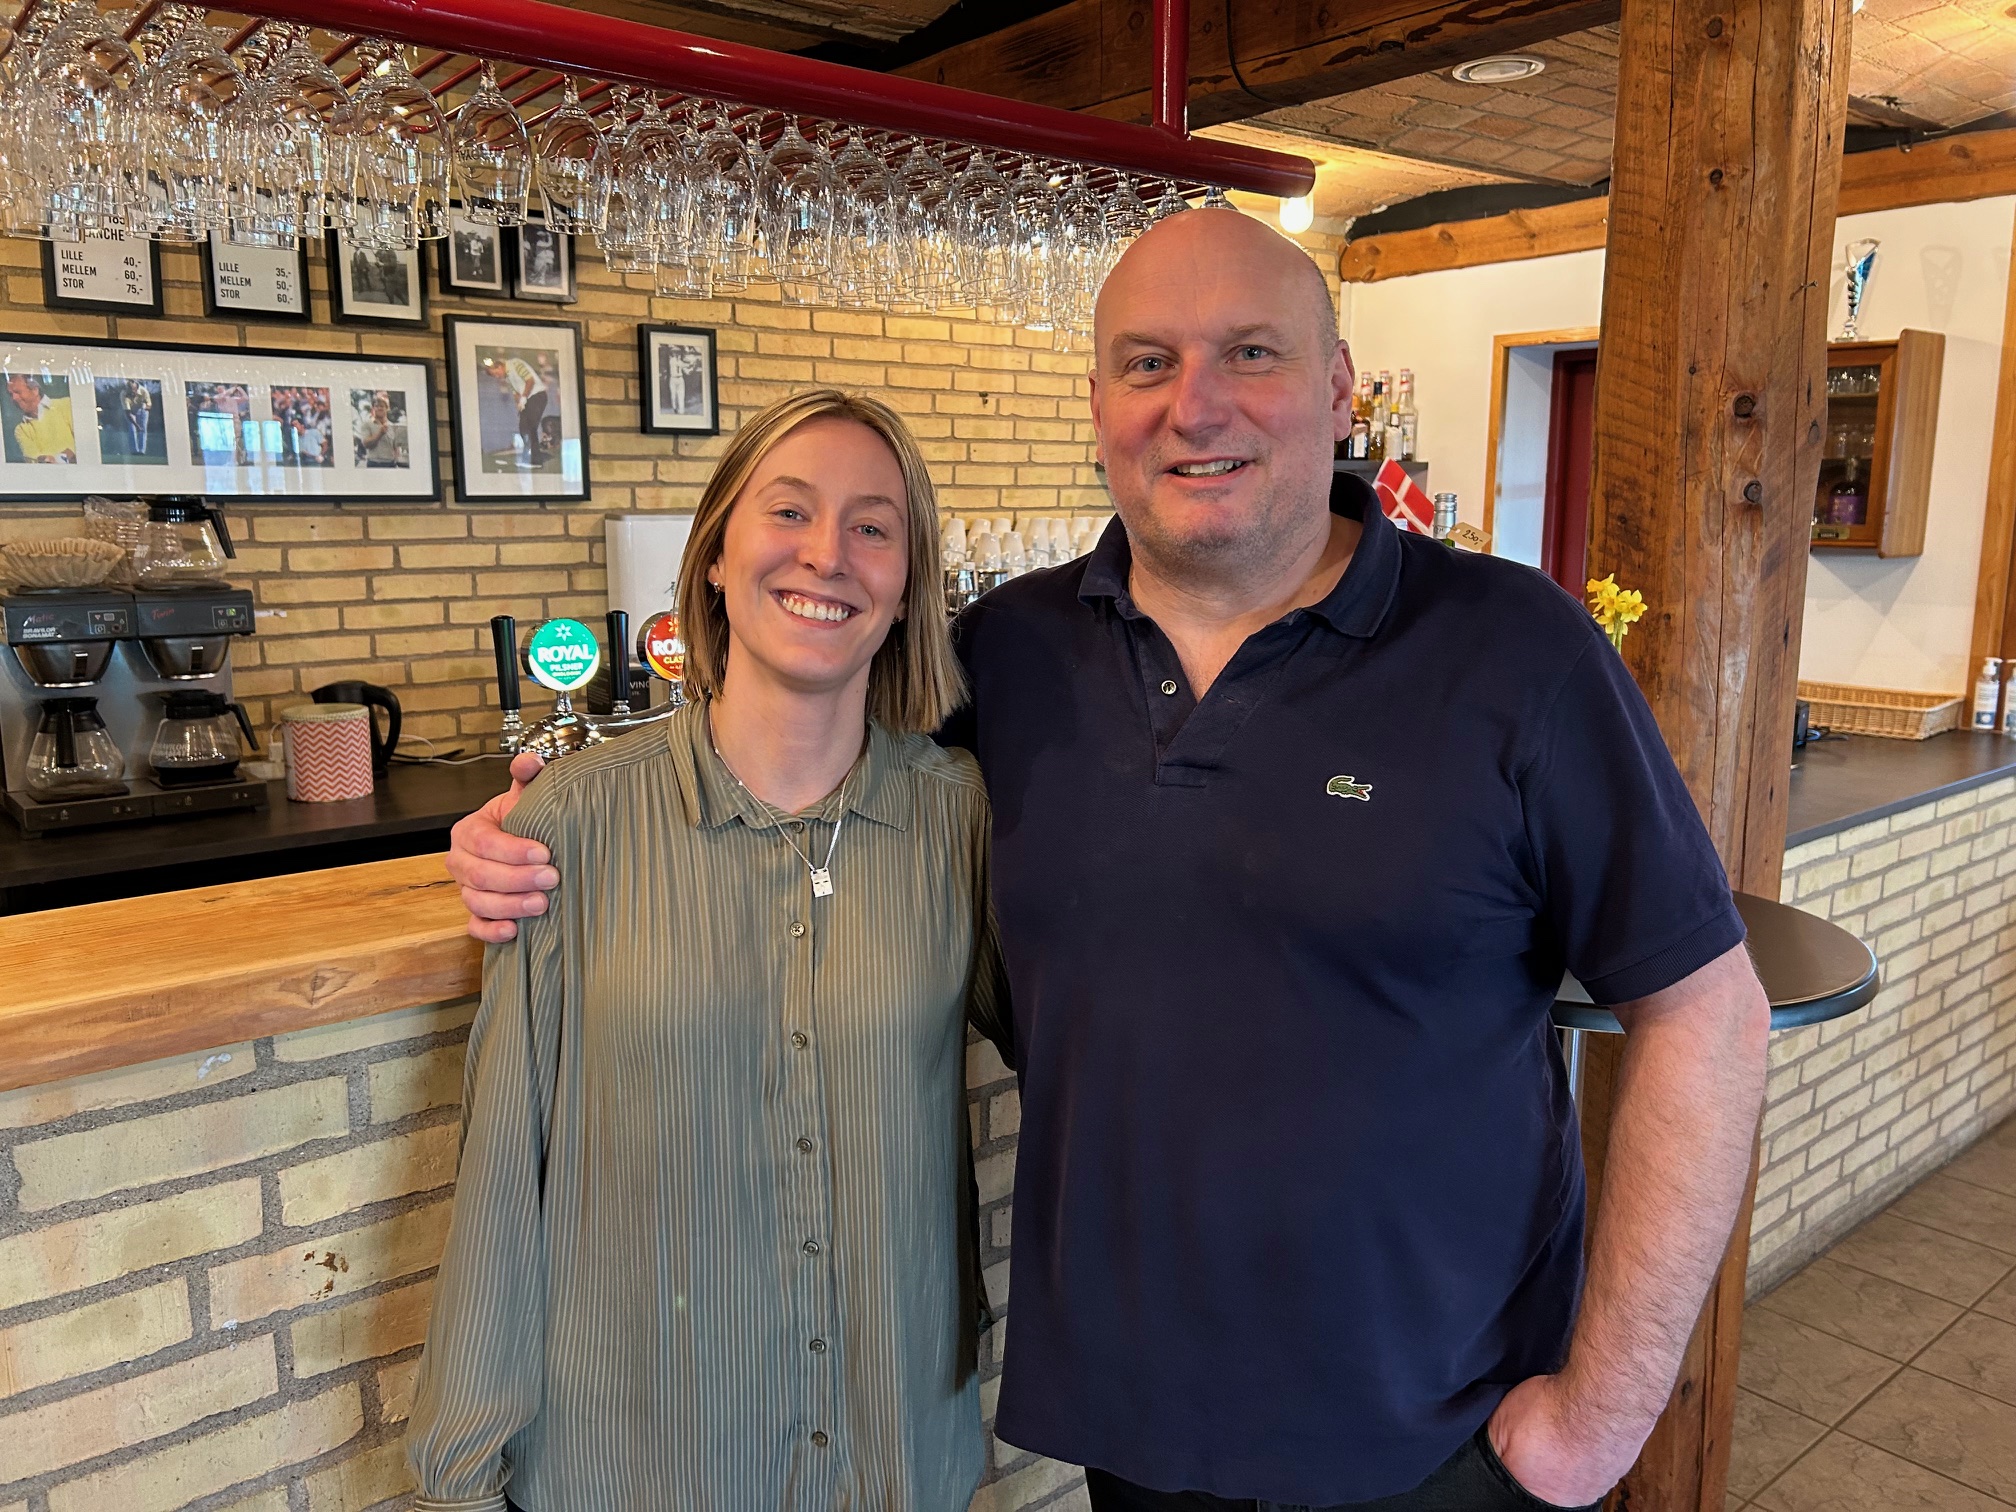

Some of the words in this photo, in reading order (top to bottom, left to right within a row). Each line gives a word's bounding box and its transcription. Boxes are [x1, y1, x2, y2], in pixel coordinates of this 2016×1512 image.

[61, 249, 83, 261] LILLE
[123, 256, 141, 268] 40,-
[62, 263, 97, 276] MELLEM
[124, 270, 142, 281] 60,-
[219, 262, 239, 273] LILLE
[275, 267, 291, 278] 35,-
[62, 277, 84, 289] STOR
[126, 283, 143, 295] 75,-
[220, 275, 252, 287] MELLEM
[276, 280, 292, 291] 50,-
[220, 288, 240, 299] STOR
[277, 293, 293, 304] 60,-
[537, 643, 594, 663] ROYAL
[663, 655, 685, 664] CLAS
